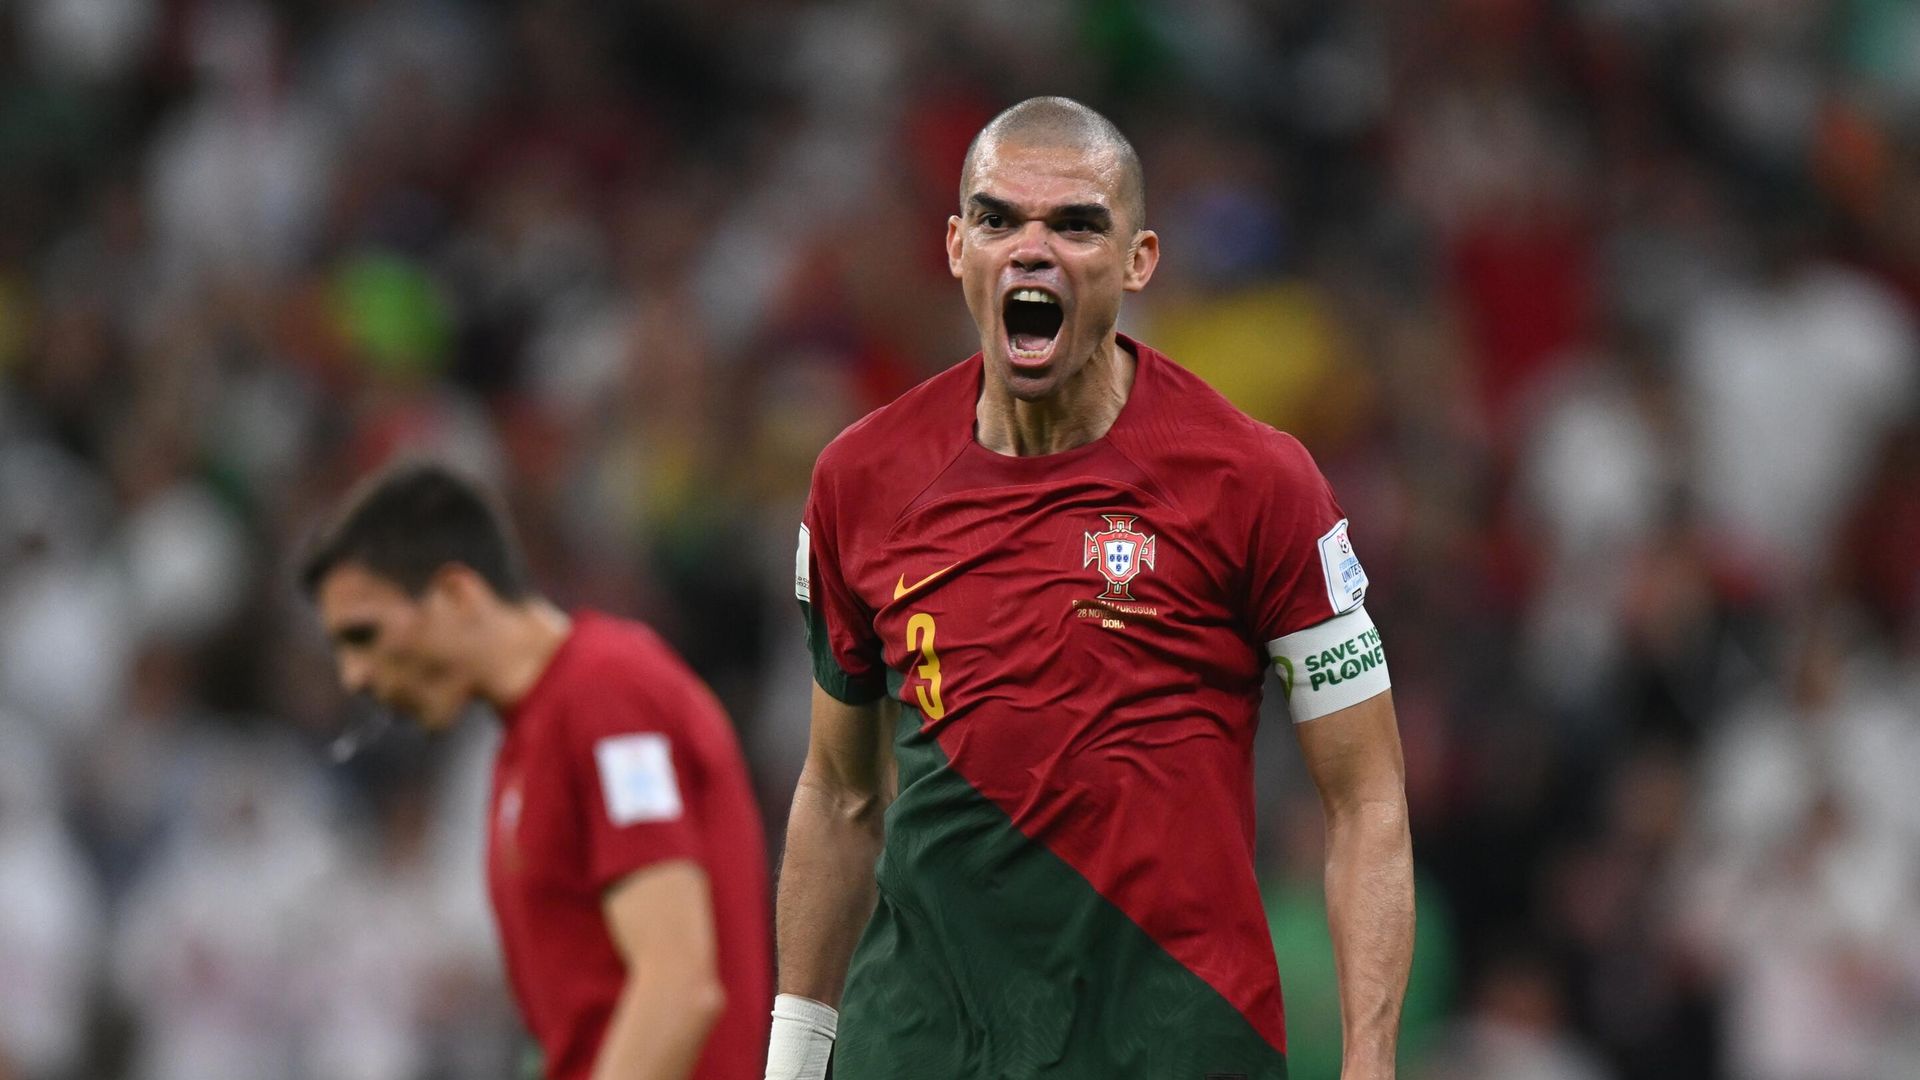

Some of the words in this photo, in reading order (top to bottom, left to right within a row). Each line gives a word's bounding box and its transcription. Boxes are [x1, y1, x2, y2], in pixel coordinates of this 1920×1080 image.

[1077, 608, 1087, 618] 28
[1102, 619, 1126, 629] DOHA
[907, 613, 945, 720] 3
[1305, 639, 1359, 671] SAVE
[1309, 644, 1384, 691] PLANE
